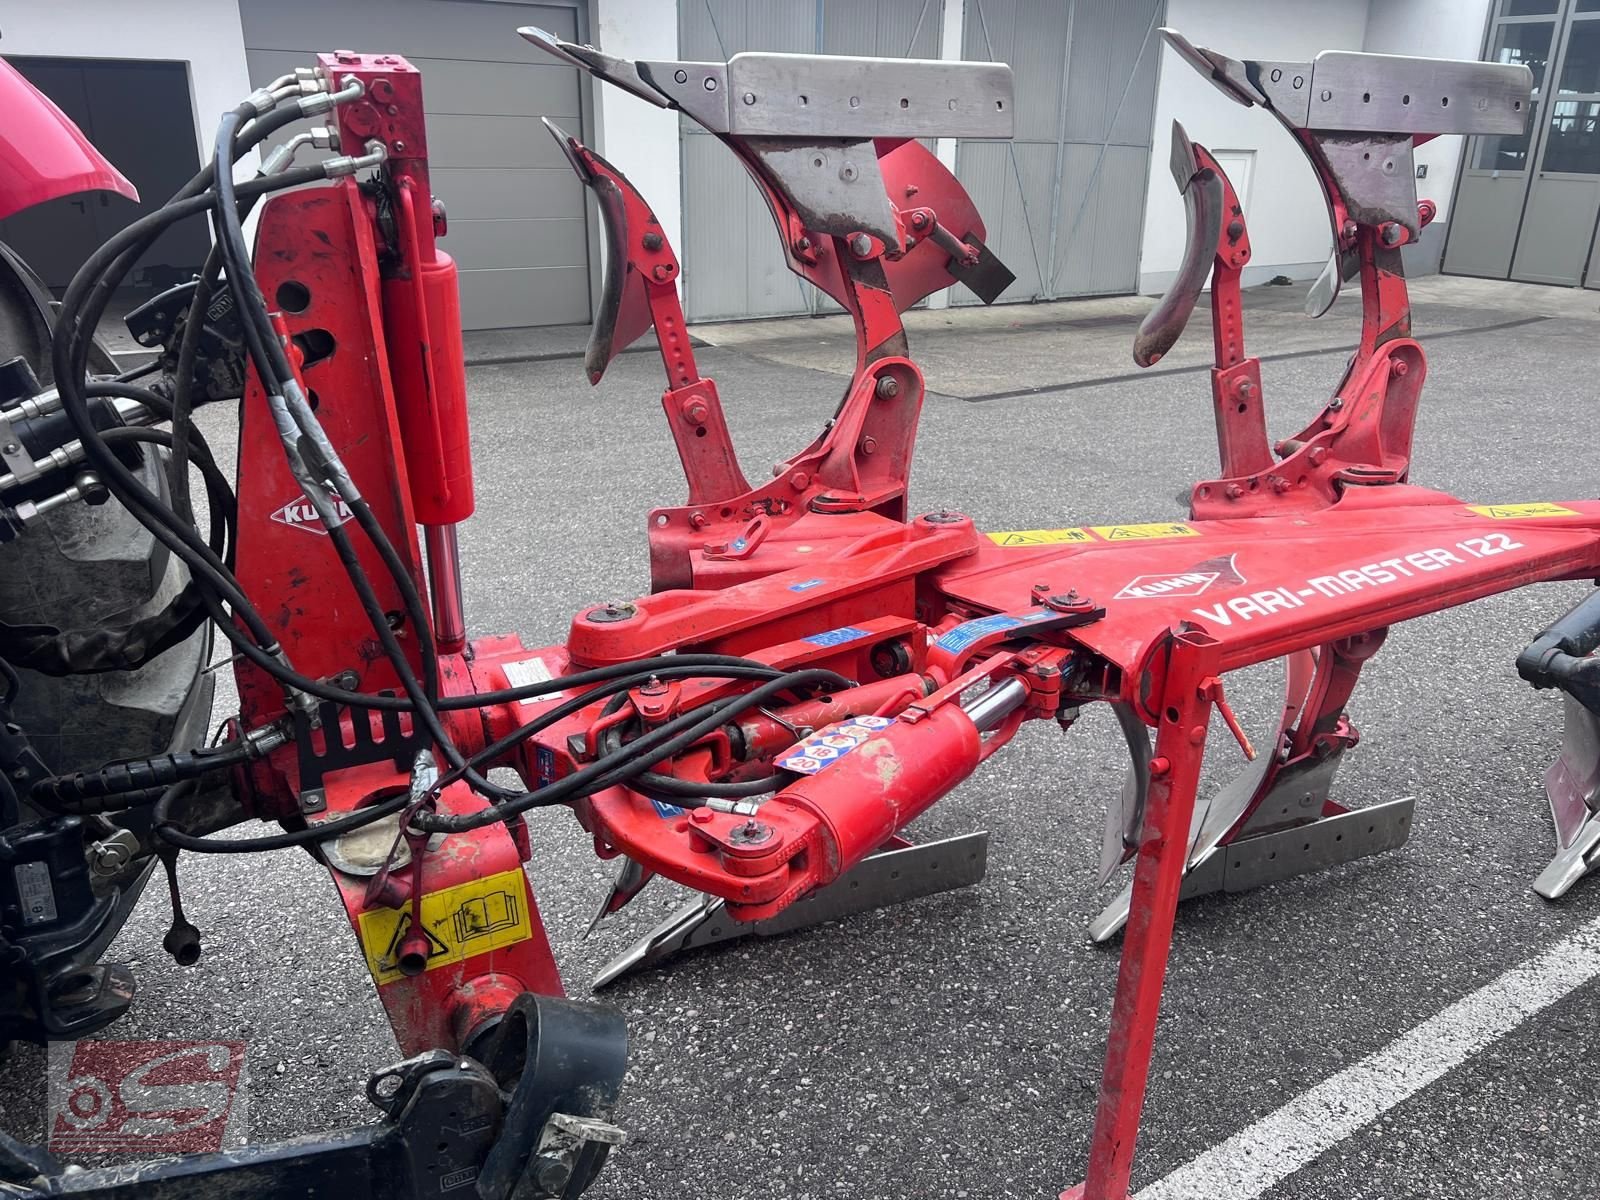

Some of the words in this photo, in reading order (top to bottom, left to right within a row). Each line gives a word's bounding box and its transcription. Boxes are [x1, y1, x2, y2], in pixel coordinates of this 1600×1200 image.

[284, 501, 354, 523] KUN
[1123, 573, 1211, 597] KUHN
[1192, 548, 1466, 626] VARI-MASTER
[1455, 533, 1526, 558] 122
[812, 747, 831, 757] 18
[791, 758, 816, 769] 20
